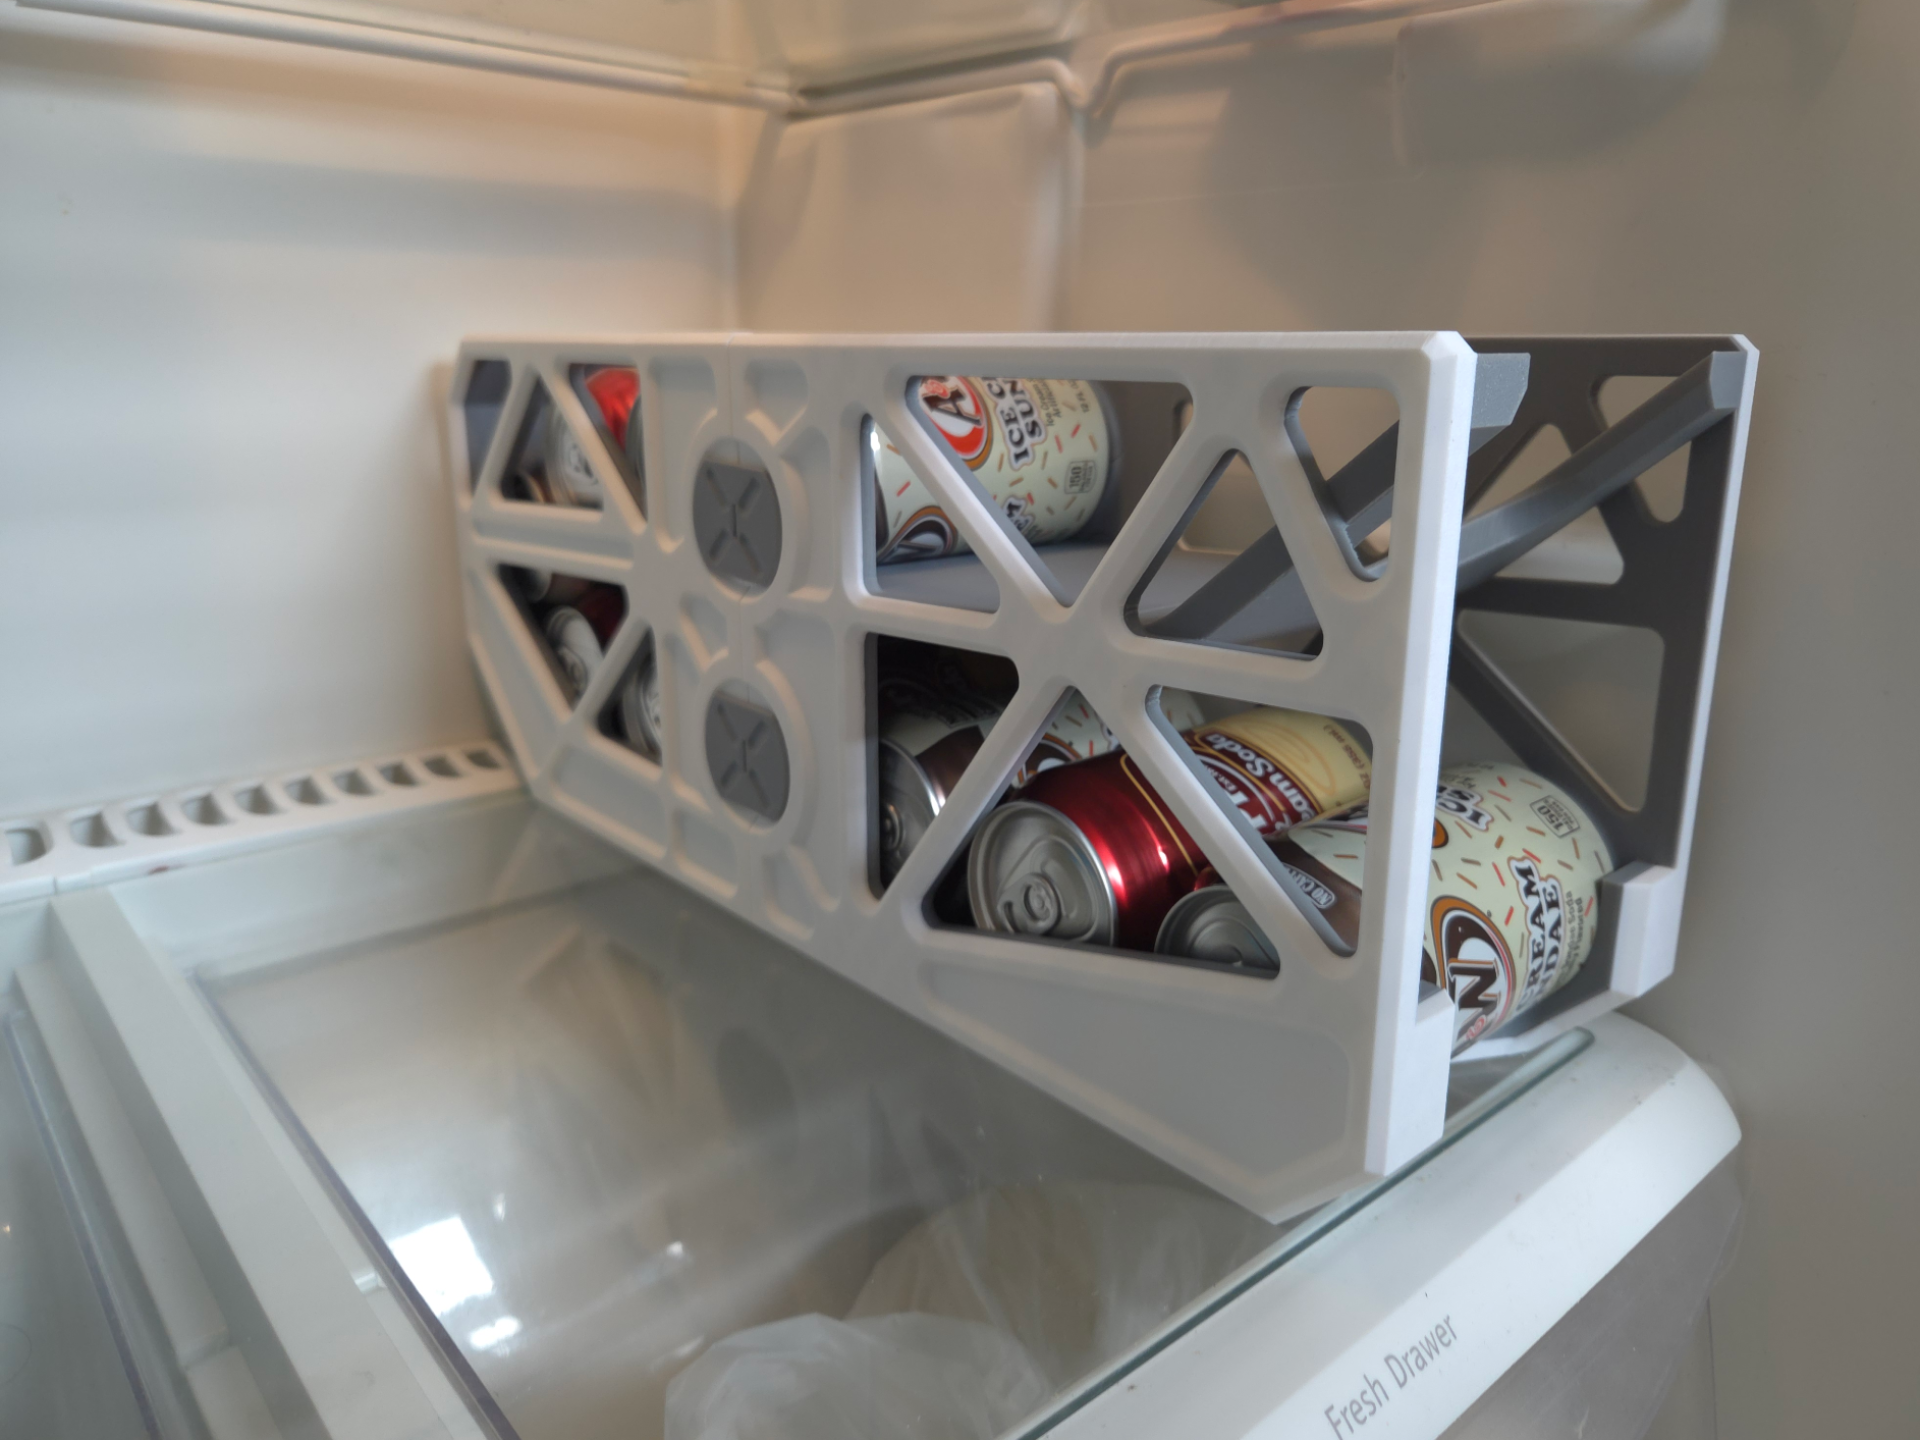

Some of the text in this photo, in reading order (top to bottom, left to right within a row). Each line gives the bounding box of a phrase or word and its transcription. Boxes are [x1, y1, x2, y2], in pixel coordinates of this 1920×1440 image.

[1003, 379, 1042, 438] SUN
[1000, 407, 1030, 464] ICE
[1205, 732, 1275, 778] Soda
[1437, 798, 1484, 826] IC
[1536, 804, 1563, 831] 150
[1324, 1314, 1458, 1440] Fresh Drawer
